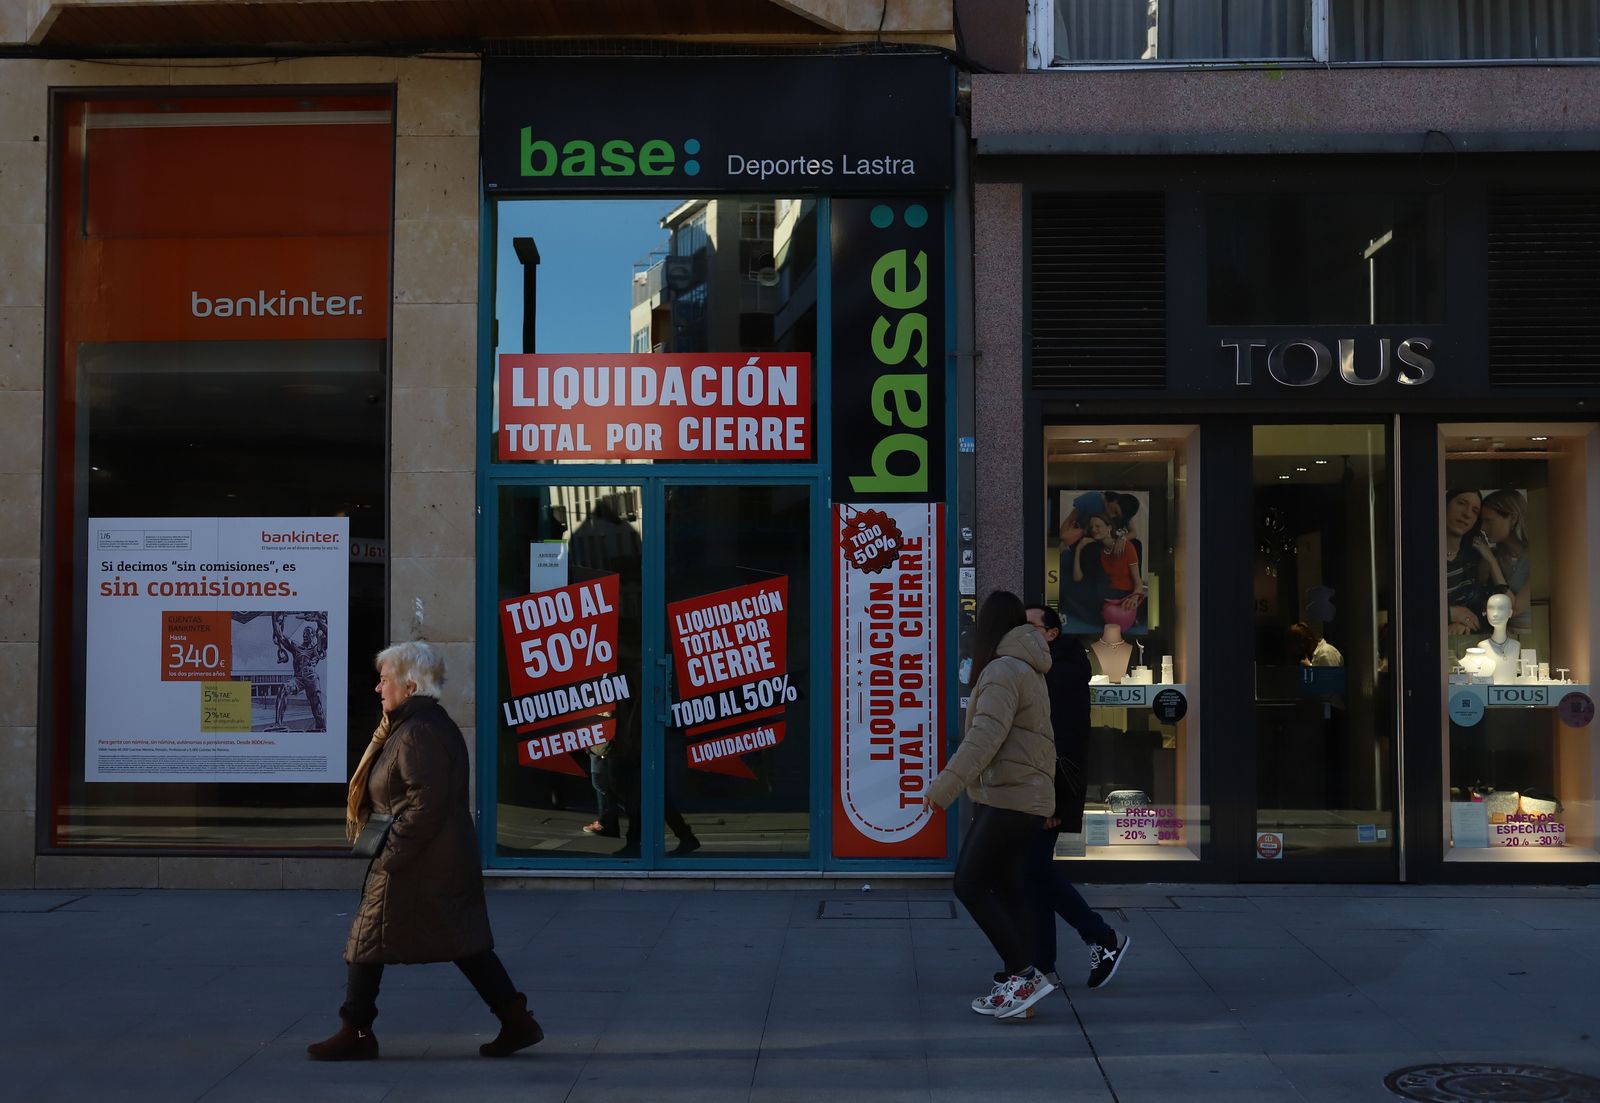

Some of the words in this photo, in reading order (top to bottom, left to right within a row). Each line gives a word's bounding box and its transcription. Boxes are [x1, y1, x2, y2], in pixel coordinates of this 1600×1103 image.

[727, 154, 833, 179] Deportes
[842, 155, 915, 175] Lastra
[1221, 337, 1436, 386] TOUS
[512, 357, 797, 410] LIQUIDACIÓN
[505, 423, 592, 452] TOTAL
[606, 423, 662, 452] POR
[678, 416, 805, 452] CIERRE
[849, 524, 882, 549] TODO
[854, 536, 896, 566] 50%
[101, 561, 113, 572] Si
[117, 561, 168, 572] decimos
[283, 564, 296, 572] es
[100, 576, 139, 597] sin
[147, 576, 298, 597] comisiones.
[899, 536, 924, 637] CIERRE
[505, 591, 574, 634] TODO
[580, 583, 613, 619] AL
[675, 589, 784, 636] LIQUIDACIÓN
[520, 623, 613, 679] 50%
[680, 627, 734, 657] TOTAL
[735, 618, 770, 645] POR
[687, 640, 776, 688] CIERRE
[864, 583, 894, 761] LIQUIDACIÓN
[899, 653, 924, 708] POR
[503, 673, 630, 727] LIQUIDACIÓN
[671, 695, 716, 728] TODO
[719, 690, 742, 717] AL
[742, 674, 798, 712] 50%
[1494, 689, 1544, 702] TOUS
[204, 711, 219, 723] 2%
[527, 723, 607, 761] CIERRE
[691, 726, 777, 763] LIQUIDACIÓN
[899, 723, 924, 809] TOTAL
[1116, 818, 1184, 828] ESPECIALES
[1126, 808, 1173, 817] PRECIOS
[1497, 824, 1565, 835] ESPECIALES
[1506, 813, 1555, 823] PRECIOS
[1120, 830, 1147, 840] -20%
[1535, 836, 1563, 846] -30%
